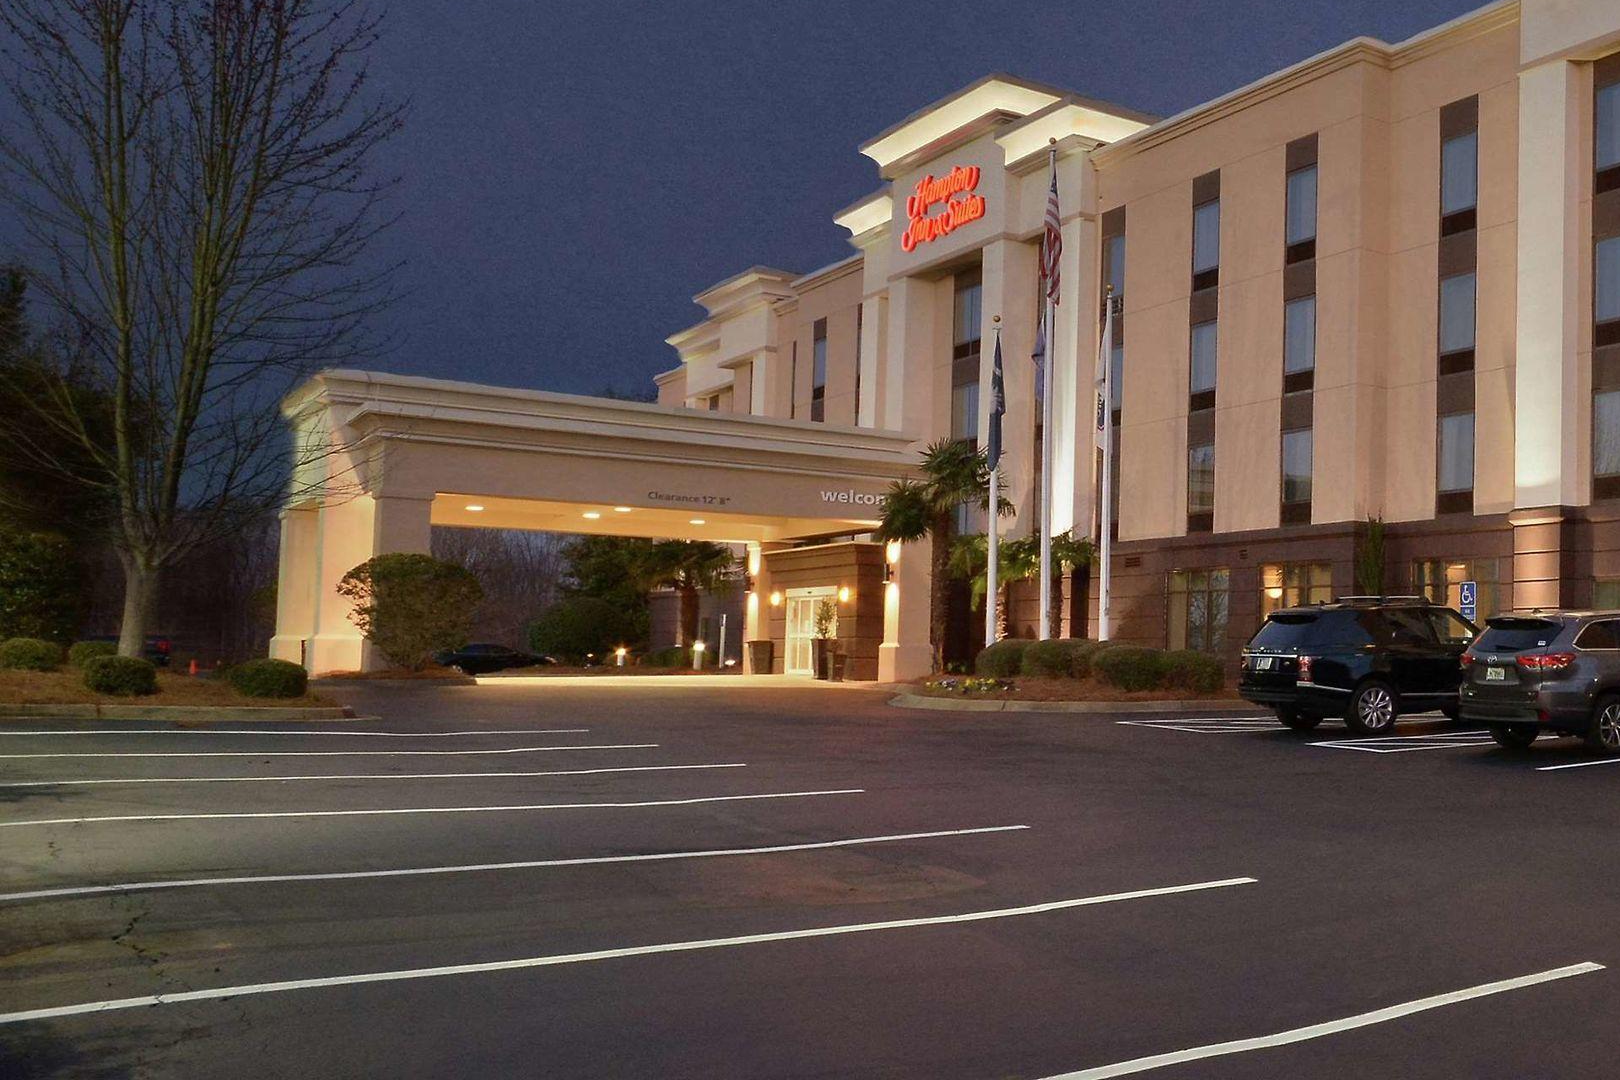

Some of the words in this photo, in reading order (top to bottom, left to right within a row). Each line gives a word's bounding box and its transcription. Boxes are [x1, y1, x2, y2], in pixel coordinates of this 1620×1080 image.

[907, 166, 980, 219] Hampton
[902, 216, 937, 252] Inn
[943, 193, 985, 232] Suites
[648, 491, 700, 503] Clearance
